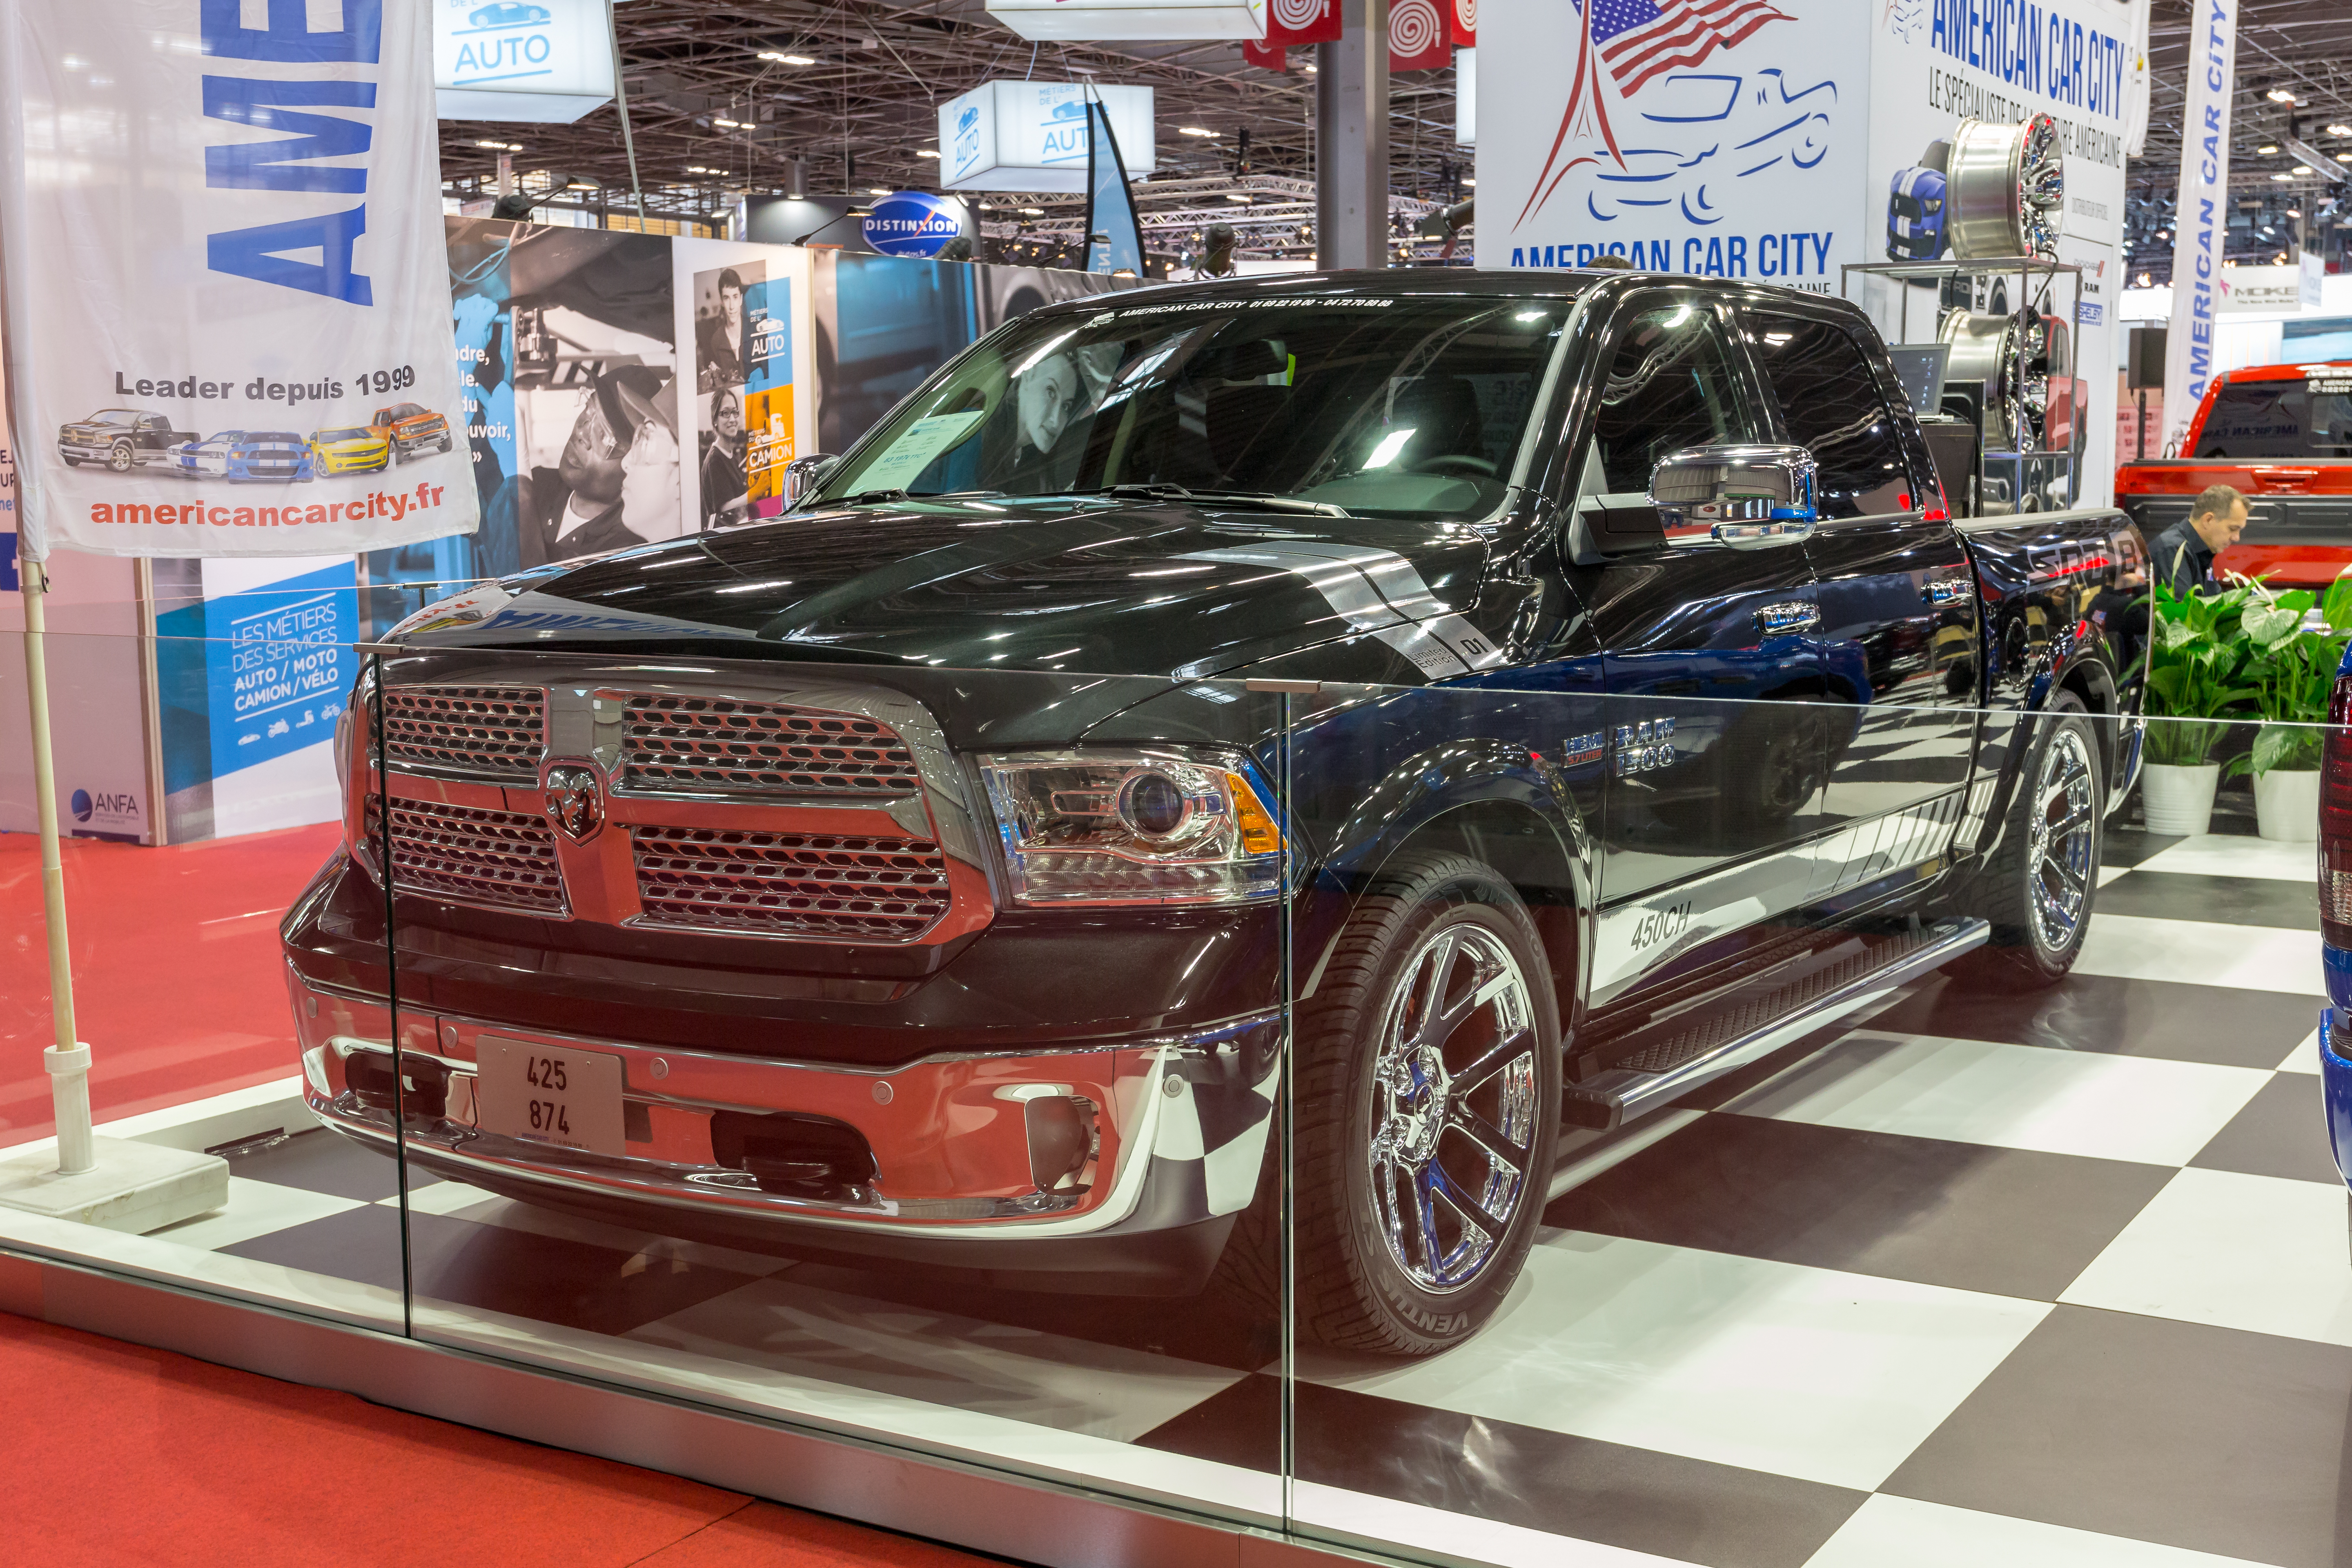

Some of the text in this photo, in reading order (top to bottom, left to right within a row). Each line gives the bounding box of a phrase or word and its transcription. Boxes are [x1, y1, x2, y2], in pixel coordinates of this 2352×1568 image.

[455, 35, 550, 72] AUTO
[1931, 0, 2125, 120] AMERICAN CAR CITY
[1039, 85, 1076, 96] MÉTIERS
[1929, 66, 1941, 109] LE
[1945, 68, 2006, 123] SPÉCIALISTE
[2076, 118, 2121, 169] AMÉRICAINE
[956, 129, 979, 169] AUTO
[2188, 0, 2226, 402] AMERICAN CAR CITY
[865, 219, 956, 232] DISTINXION
[1511, 232, 1833, 278] AMERICAN CAR CITY
[2084, 282, 2099, 294] RAM
[1118, 305, 1186, 317] AMERICAN
[751, 334, 784, 356] AUTO
[116, 365, 416, 406] Leader depuis 1999
[749, 443, 792, 468] CAMION
[91, 482, 444, 528] americancarcity.fr
[232, 602, 336, 650] LES MÉTIERS
[233, 626, 337, 673] DES SERVICES
[1405, 646, 1448, 661] Limited
[1415, 655, 1457, 668] Edition
[234, 667, 277, 693] AUTO
[294, 648, 337, 674] MOTO
[1566, 732, 1602, 755] HEMI
[1615, 717, 1675, 751] RAM
[1568, 749, 1601, 765] 5.7 LITER
[1615, 743, 1675, 777] 1500
[95, 793, 139, 814] ANFA
[1631, 900, 1691, 951] 450CH
[527, 1056, 567, 1091] 425
[530, 1100, 570, 1135] 874
[1378, 1267, 1468, 1336] VENTUS
